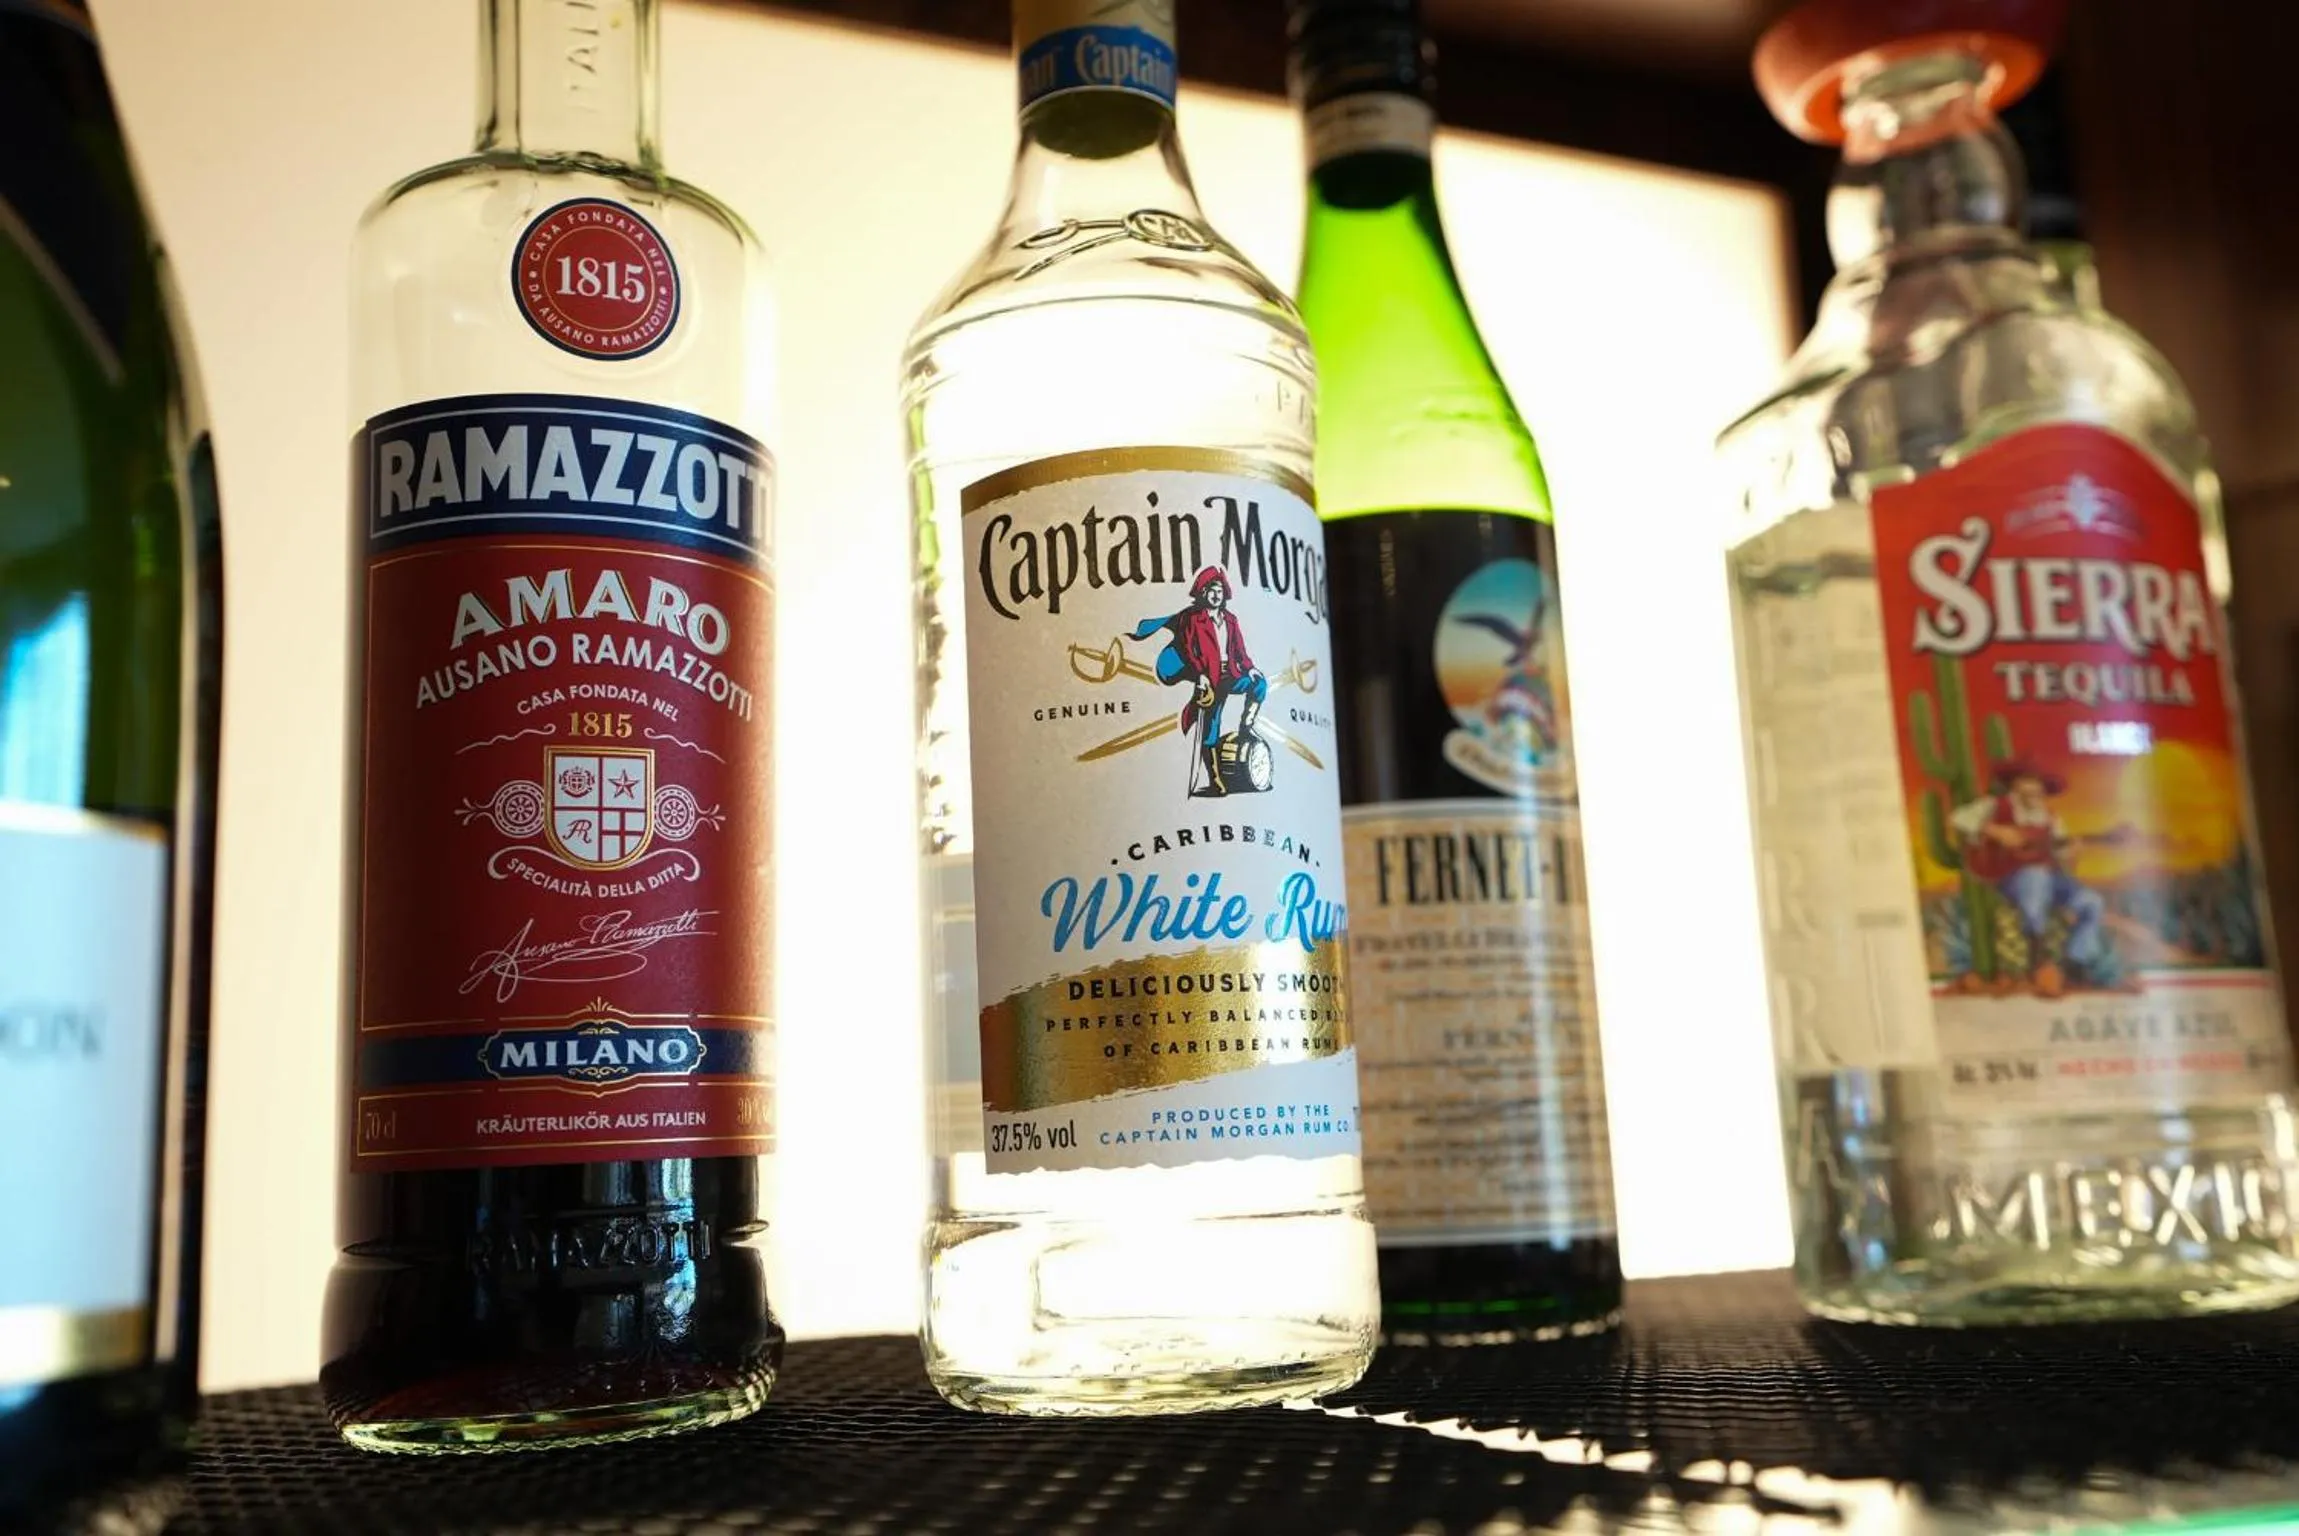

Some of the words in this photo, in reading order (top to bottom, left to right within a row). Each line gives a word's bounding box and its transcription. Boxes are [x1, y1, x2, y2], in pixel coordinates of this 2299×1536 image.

[529, 223, 562, 263] CASA
[566, 210, 645, 243] FONDATA
[647, 247, 669, 278] NEL
[556, 256, 646, 304] 1815
[528, 284, 543, 303] DA
[539, 306, 595, 346] AUSANO
[601, 299, 670, 348] RAMAZZOTTI
[979, 491, 1201, 620] Captain
[1909, 516, 2216, 662] SIERRA
[449, 567, 731, 657] AMARO
[416, 635, 557, 710] AUSANO
[572, 633, 753, 722] RAMAZZOTTI
[1994, 660, 2196, 706] TEQUILA
[517, 690, 565, 716] CASA
[569, 684, 649, 708] FONDATA
[652, 697, 681, 723] NEL
[1034, 700, 1132, 722] GENUINE
[567, 711, 633, 738] 1815
[1127, 824, 1312, 865] CARIBBEAN
[507, 857, 593, 898] SPECIALITÀ
[598, 880, 646, 898] DELLA
[649, 862, 686, 890] DITTA
[1040, 872, 1253, 953] White
[1068, 973, 1265, 1001] DELICIOUSLY
[1046, 1010, 1193, 1033] PERFECTLY
[1210, 1008, 1319, 1024] BALANCED
[500, 1037, 691, 1068] MILANO
[1104, 1042, 1133, 1058] OF
[1150, 1037, 1292, 1057] CARIBBEAN
[476, 1111, 612, 1135] KRÄUTERLIKÖR
[615, 1113, 648, 1128] AUS
[653, 1111, 707, 1128] ITALIEN
[1100, 1126, 1199, 1147] CAPTAIN
[1211, 1122, 1295, 1139] MORGAN
[1303, 1121, 1331, 1135] RUM
[1151, 1105, 1267, 1124] PRODUCED
[1277, 1105, 1296, 1118] BY
[1304, 1104, 1330, 1117] THE
[991, 1121, 1042, 1154] 37.5%
[1047, 1119, 1079, 1150] vol
